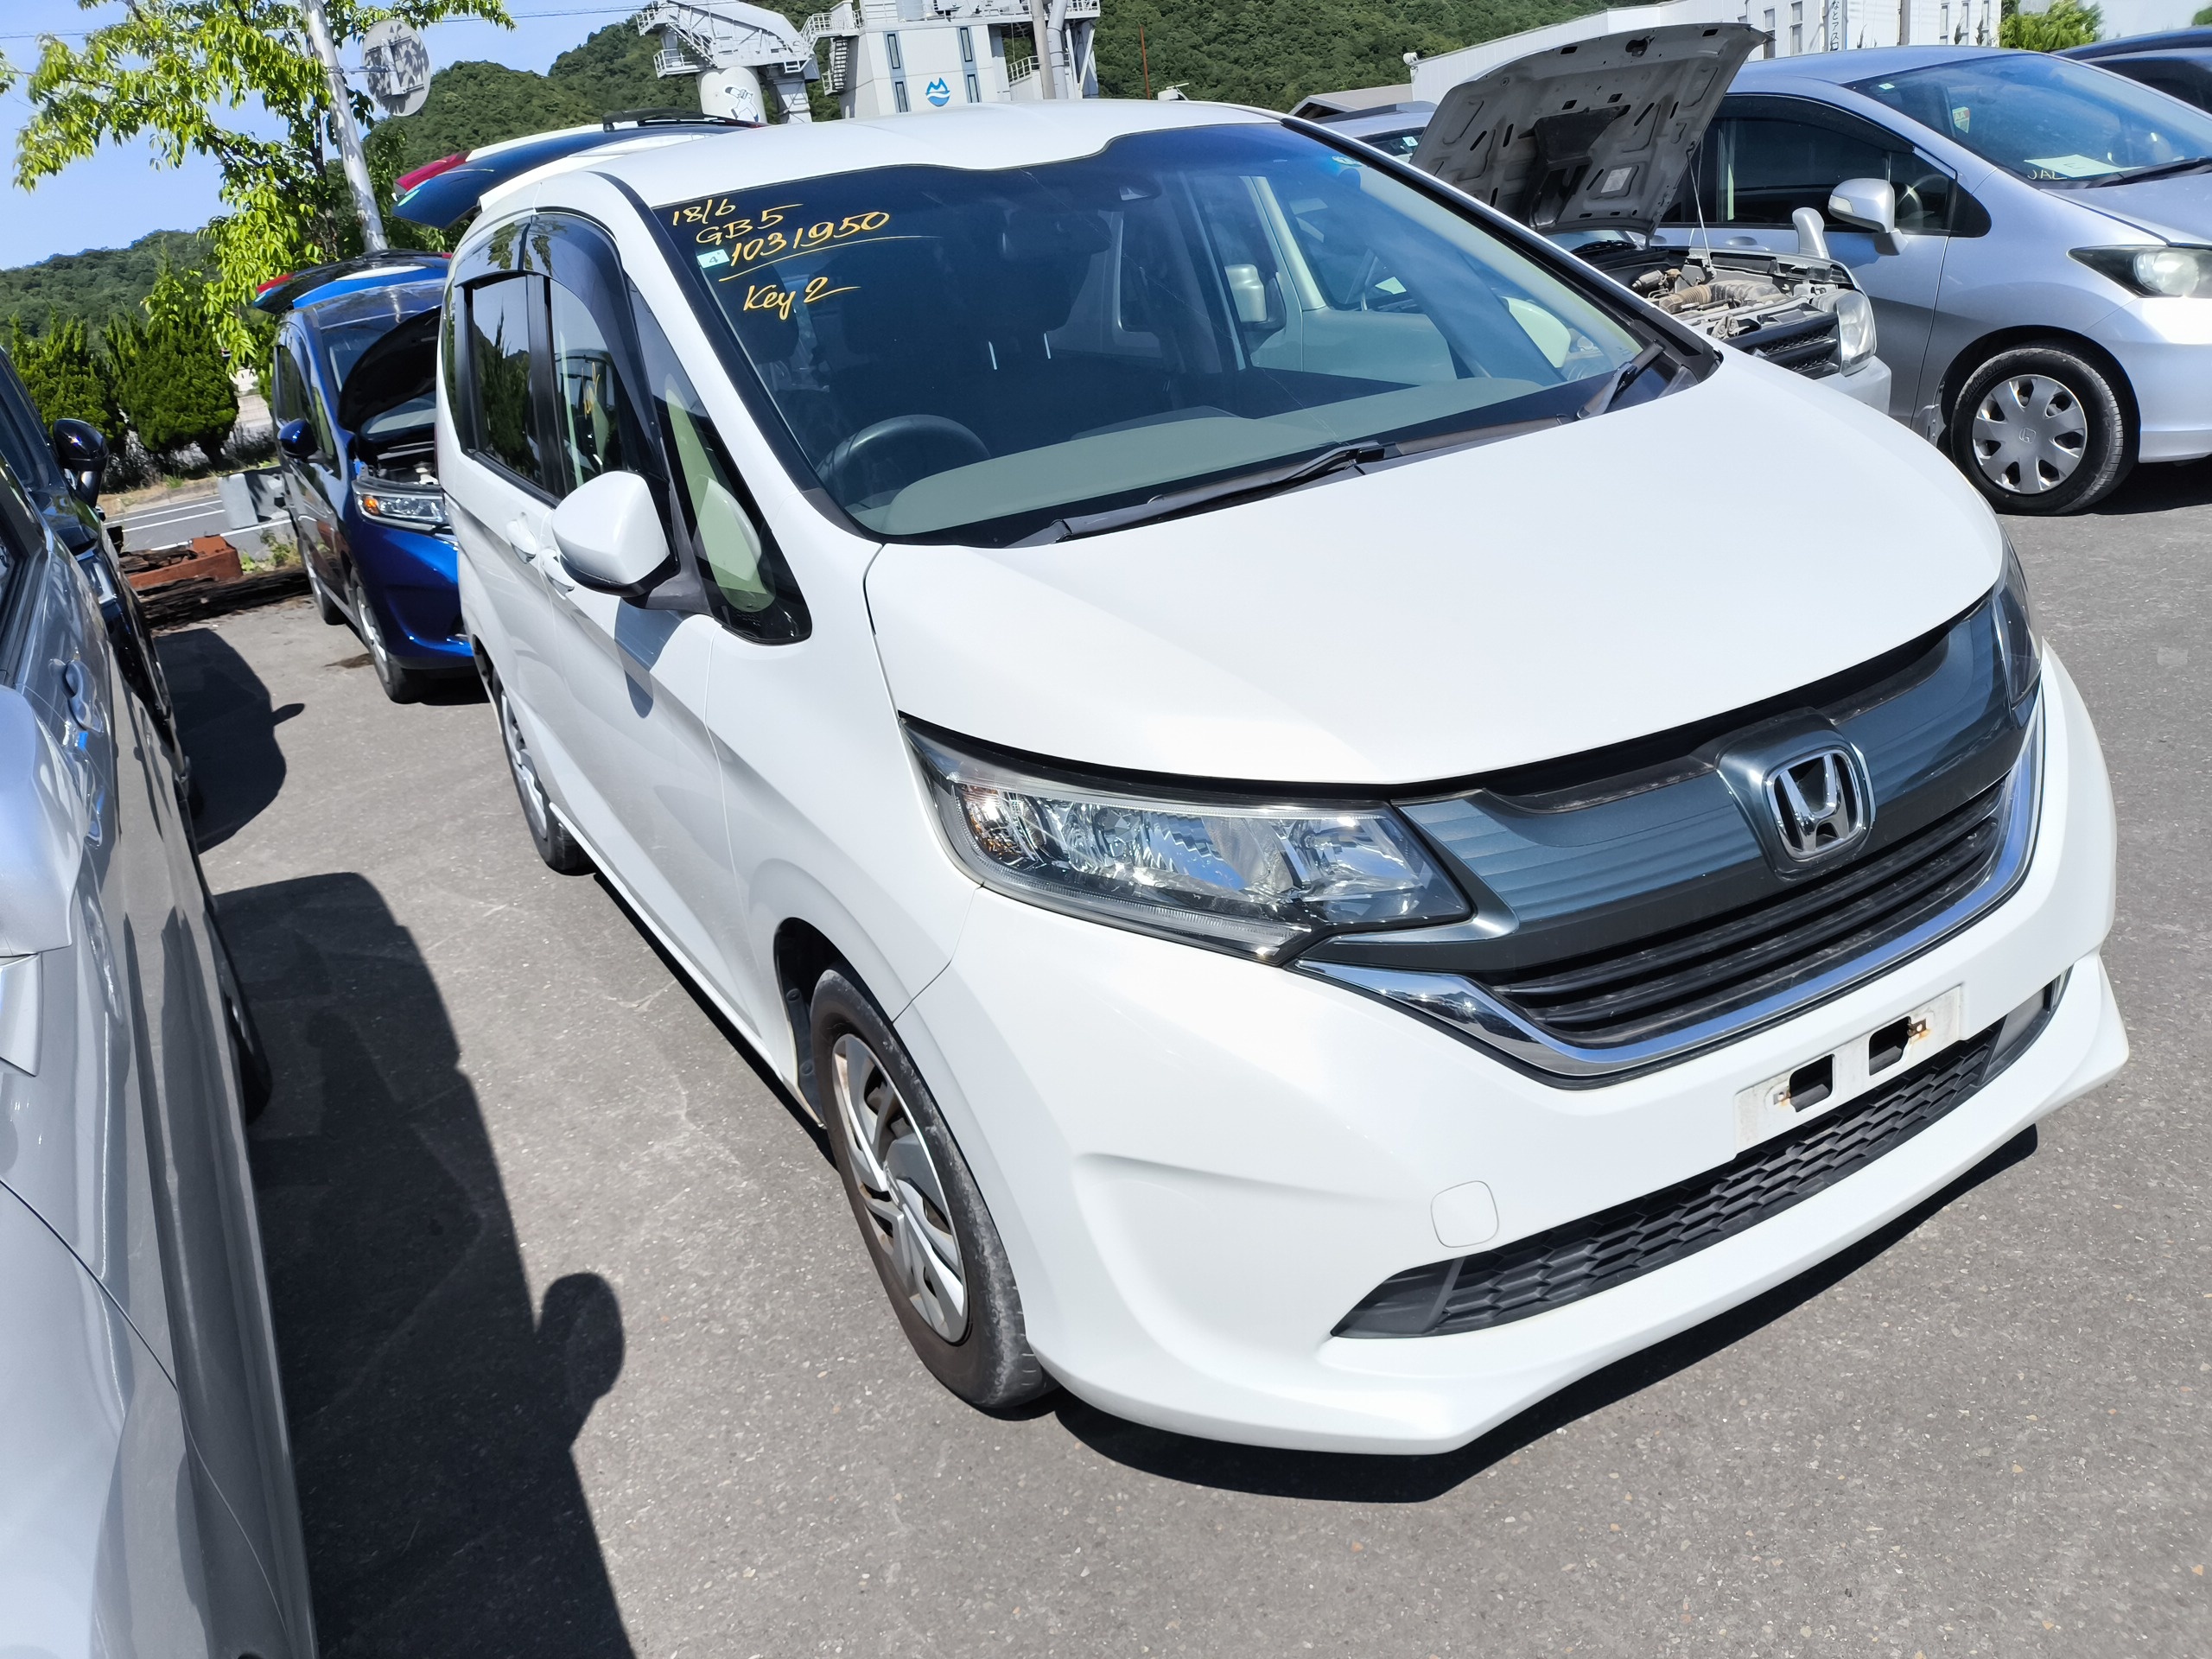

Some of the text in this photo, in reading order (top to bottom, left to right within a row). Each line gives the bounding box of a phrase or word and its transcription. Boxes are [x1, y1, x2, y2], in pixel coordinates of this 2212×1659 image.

[672, 198, 736, 226] 18/6
[743, 276, 862, 321] Key 2
